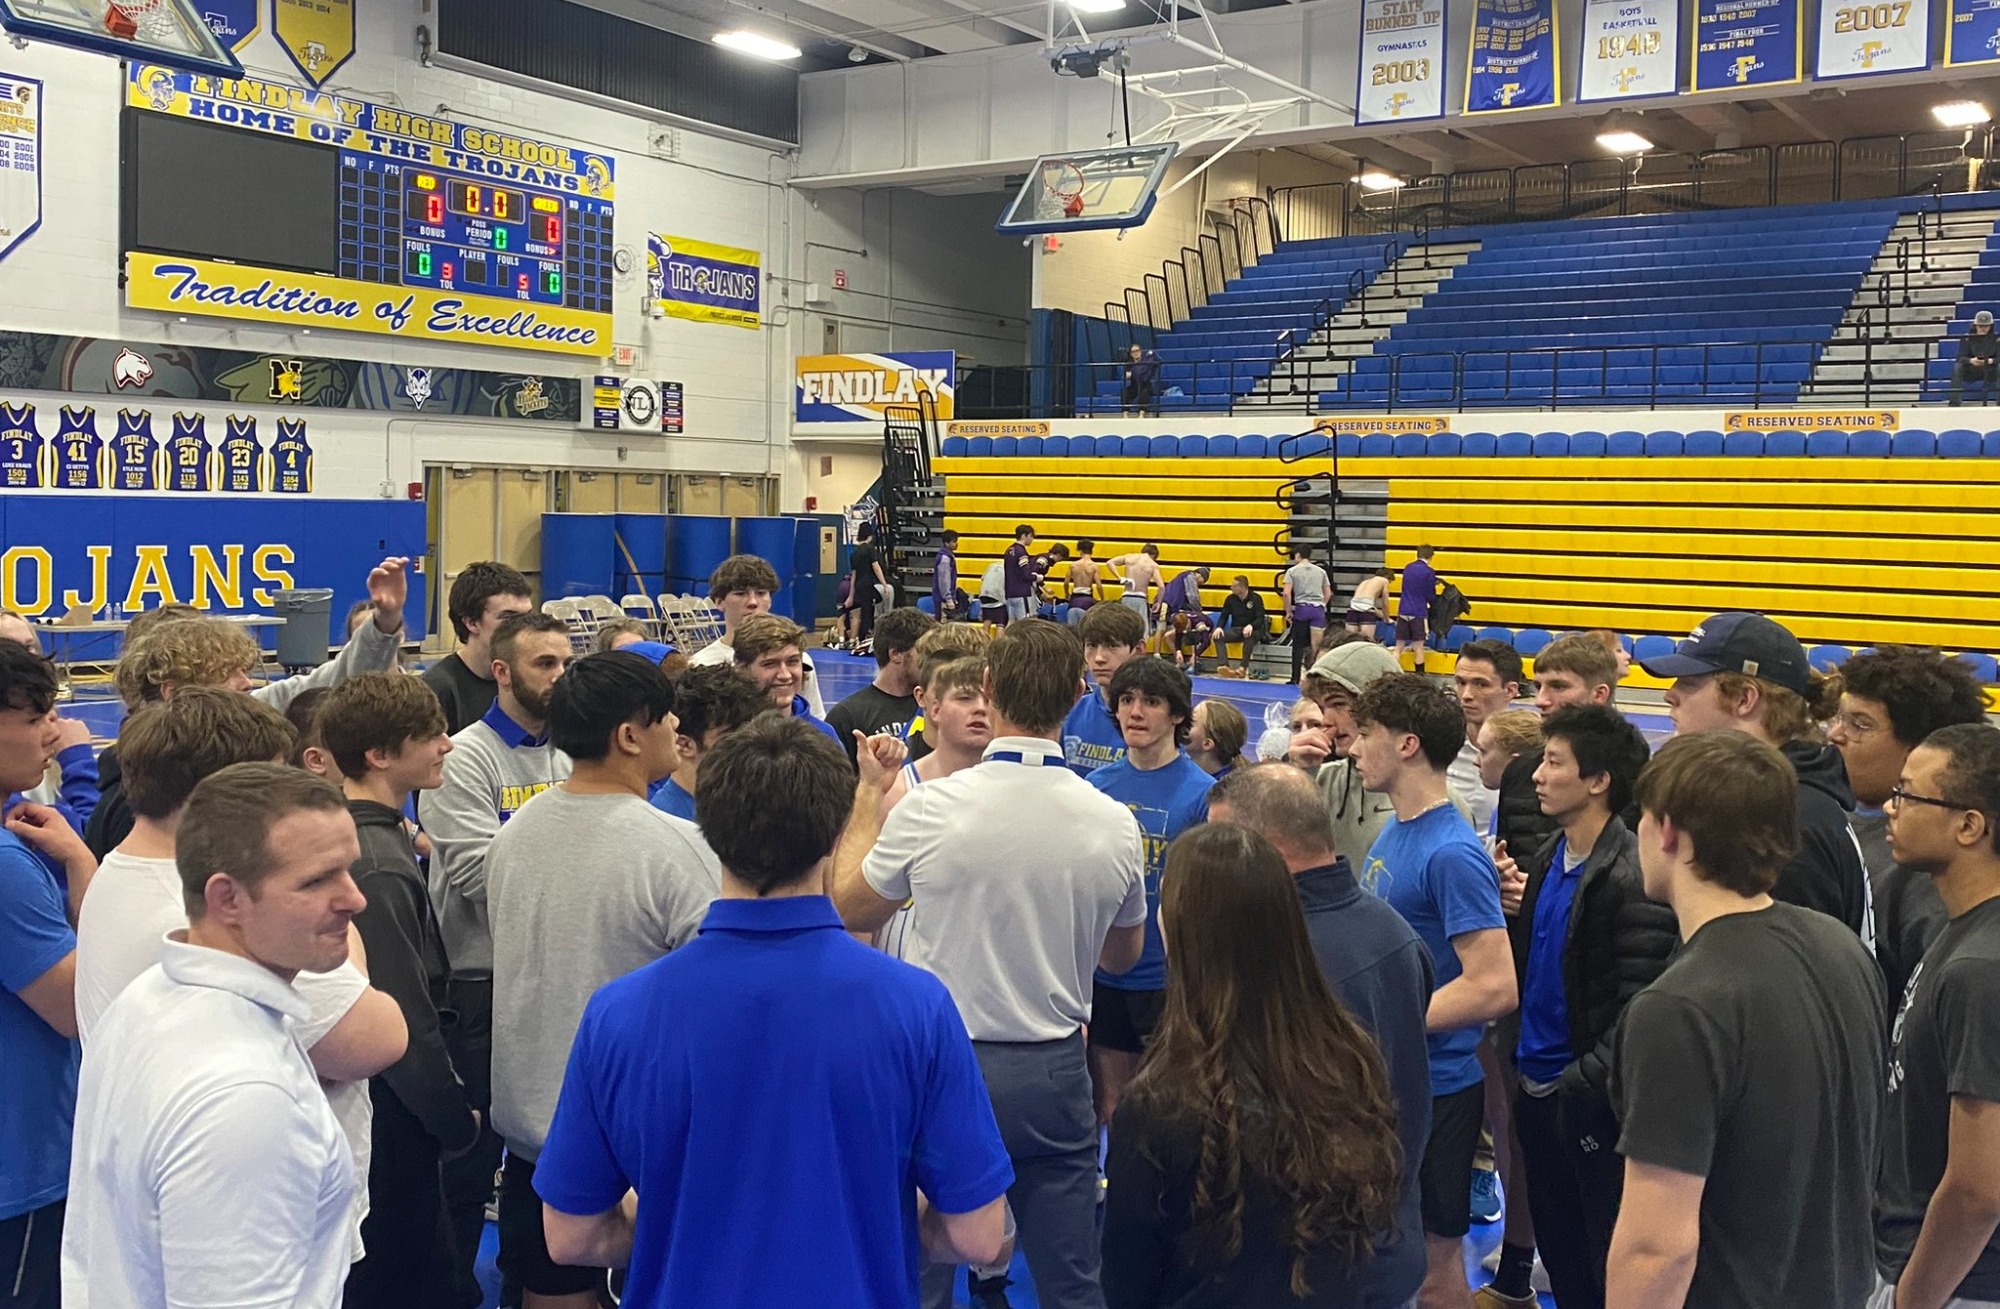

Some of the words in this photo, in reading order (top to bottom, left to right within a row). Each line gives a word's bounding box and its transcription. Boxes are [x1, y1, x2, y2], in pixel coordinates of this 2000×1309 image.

[1423, 10, 1441, 24] UP
[1619, 6, 1641, 16] BOYS
[1835, 1, 1912, 33] 2007
[1372, 58, 1430, 86] 2003
[189, 98, 295, 135] HOME
[310, 123, 353, 144] OF
[366, 133, 432, 162] THE
[444, 151, 579, 191] TROJANS
[372, 105, 455, 148] HIGH
[461, 127, 577, 172] SCHOOL
[344, 156, 356, 167] NO
[368, 160, 374, 170] F
[384, 163, 400, 175] PTS
[427, 195, 443, 225] 0
[569, 199, 579, 210] NO
[587, 203, 593, 212] F
[600, 206, 613, 217] PTS
[419, 225, 446, 239] BONUS
[465, 226, 492, 240] PERIOD
[547, 216, 560, 244] 0
[495, 227, 507, 250] 0
[406, 240, 431, 252] FOULS
[525, 243, 549, 255] BONUS
[459, 248, 486, 261] PLAYER
[497, 254, 519, 266] FOULS
[419, 252, 431, 276] 0
[442, 262, 453, 280] 3
[538, 261, 560, 273] FOULS
[439, 279, 455, 290] TOL
[549, 272, 560, 294] 0
[669, 262, 755, 300] TROJANS
[517, 290, 530, 300] TOL
[154, 264, 360, 319] Tradition
[375, 295, 414, 331] of
[427, 299, 597, 346] Excellence
[619, 348, 631, 360] EXIT
[802, 369, 948, 405] FINDLAY
[1385, 421, 1431, 430] SEATING
[1747, 416, 1813, 427] RESERVED
[1817, 415, 1875, 426] SEATING
[1, 429, 33, 441] FINDLAY
[959, 425, 999, 433] RESERVED
[1001, 425, 1037, 433] SEATING
[62, 431, 93, 444] FINDLAY
[120, 434, 149, 446] FINDLAY
[175, 436, 202, 448] FINDLAY
[228, 438, 254, 450] FINDLAY
[11, 440, 23, 460] 3
[67, 442, 88, 461] 41
[278, 440, 304, 452] FINDLAY
[125, 444, 145, 464] 15
[180, 446, 199, 465] 20
[231, 448, 250, 467] 23
[286, 450, 296, 468] 4
[8, 469, 26, 477] 1501
[126, 472, 143, 480] 1012
